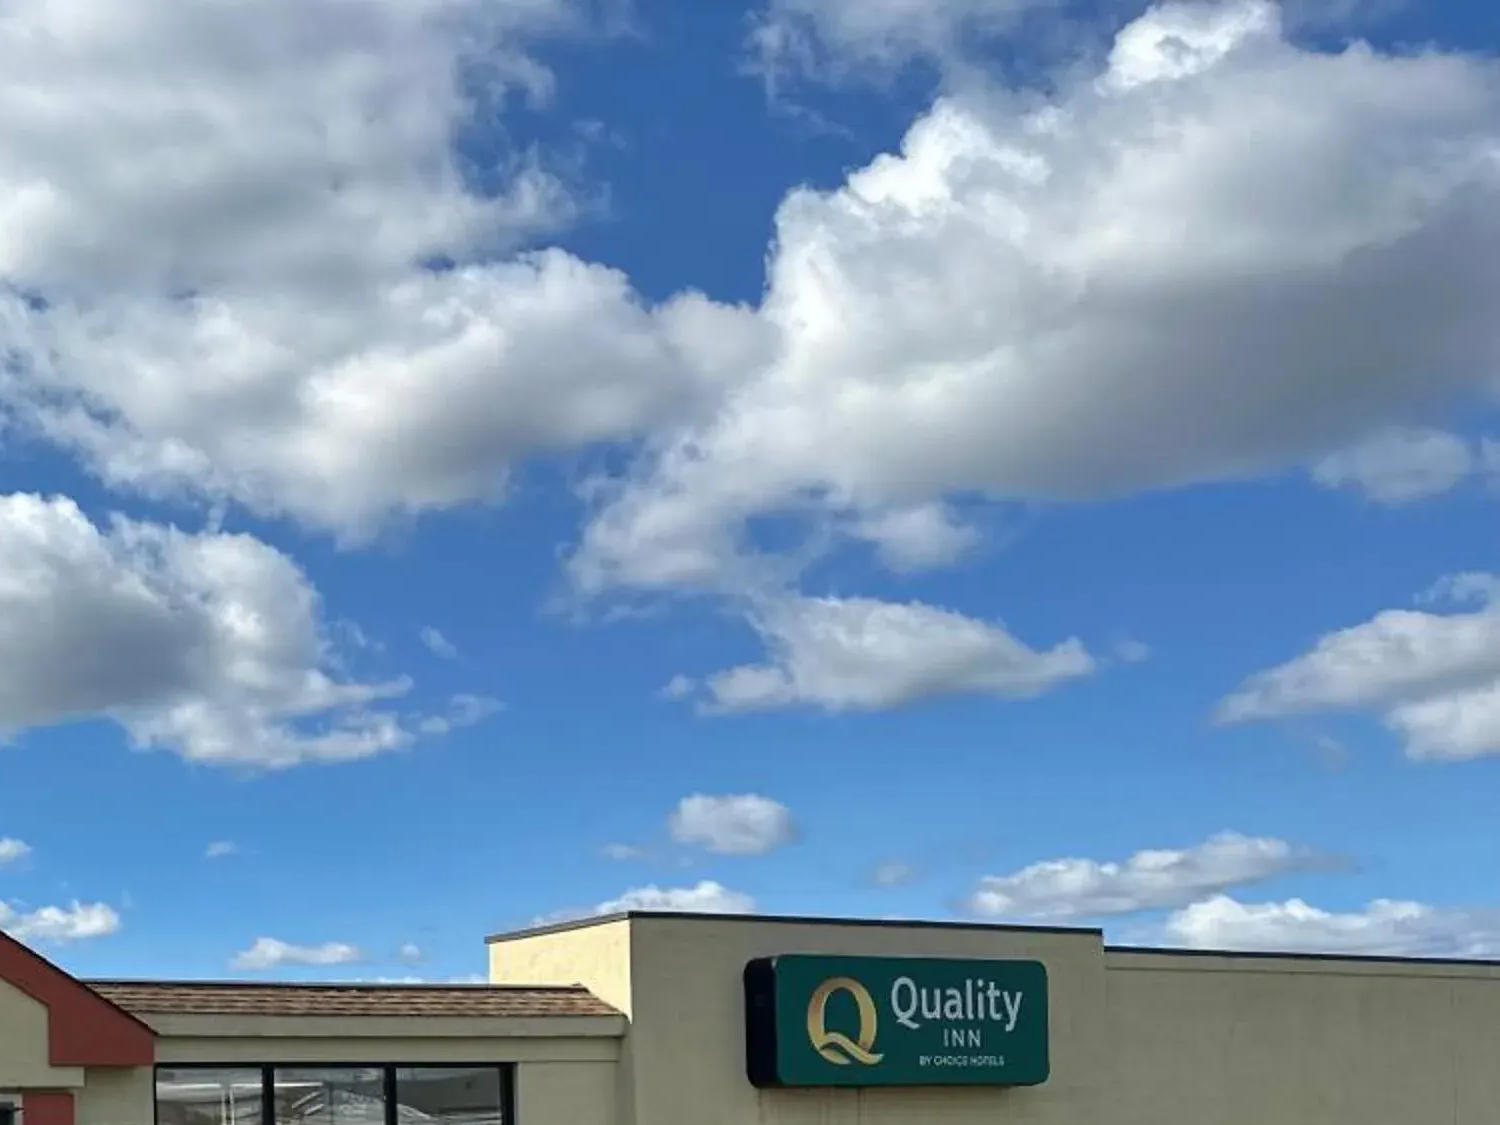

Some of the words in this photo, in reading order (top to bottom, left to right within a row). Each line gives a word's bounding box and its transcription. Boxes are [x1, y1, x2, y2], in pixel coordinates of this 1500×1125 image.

[807, 976, 885, 1066] Q
[891, 976, 1023, 1032] Quality
[943, 1028, 981, 1048] INN
[919, 1055, 931, 1067] BY
[933, 1055, 968, 1067] CHOICE
[969, 1055, 1005, 1067] HOTELS
